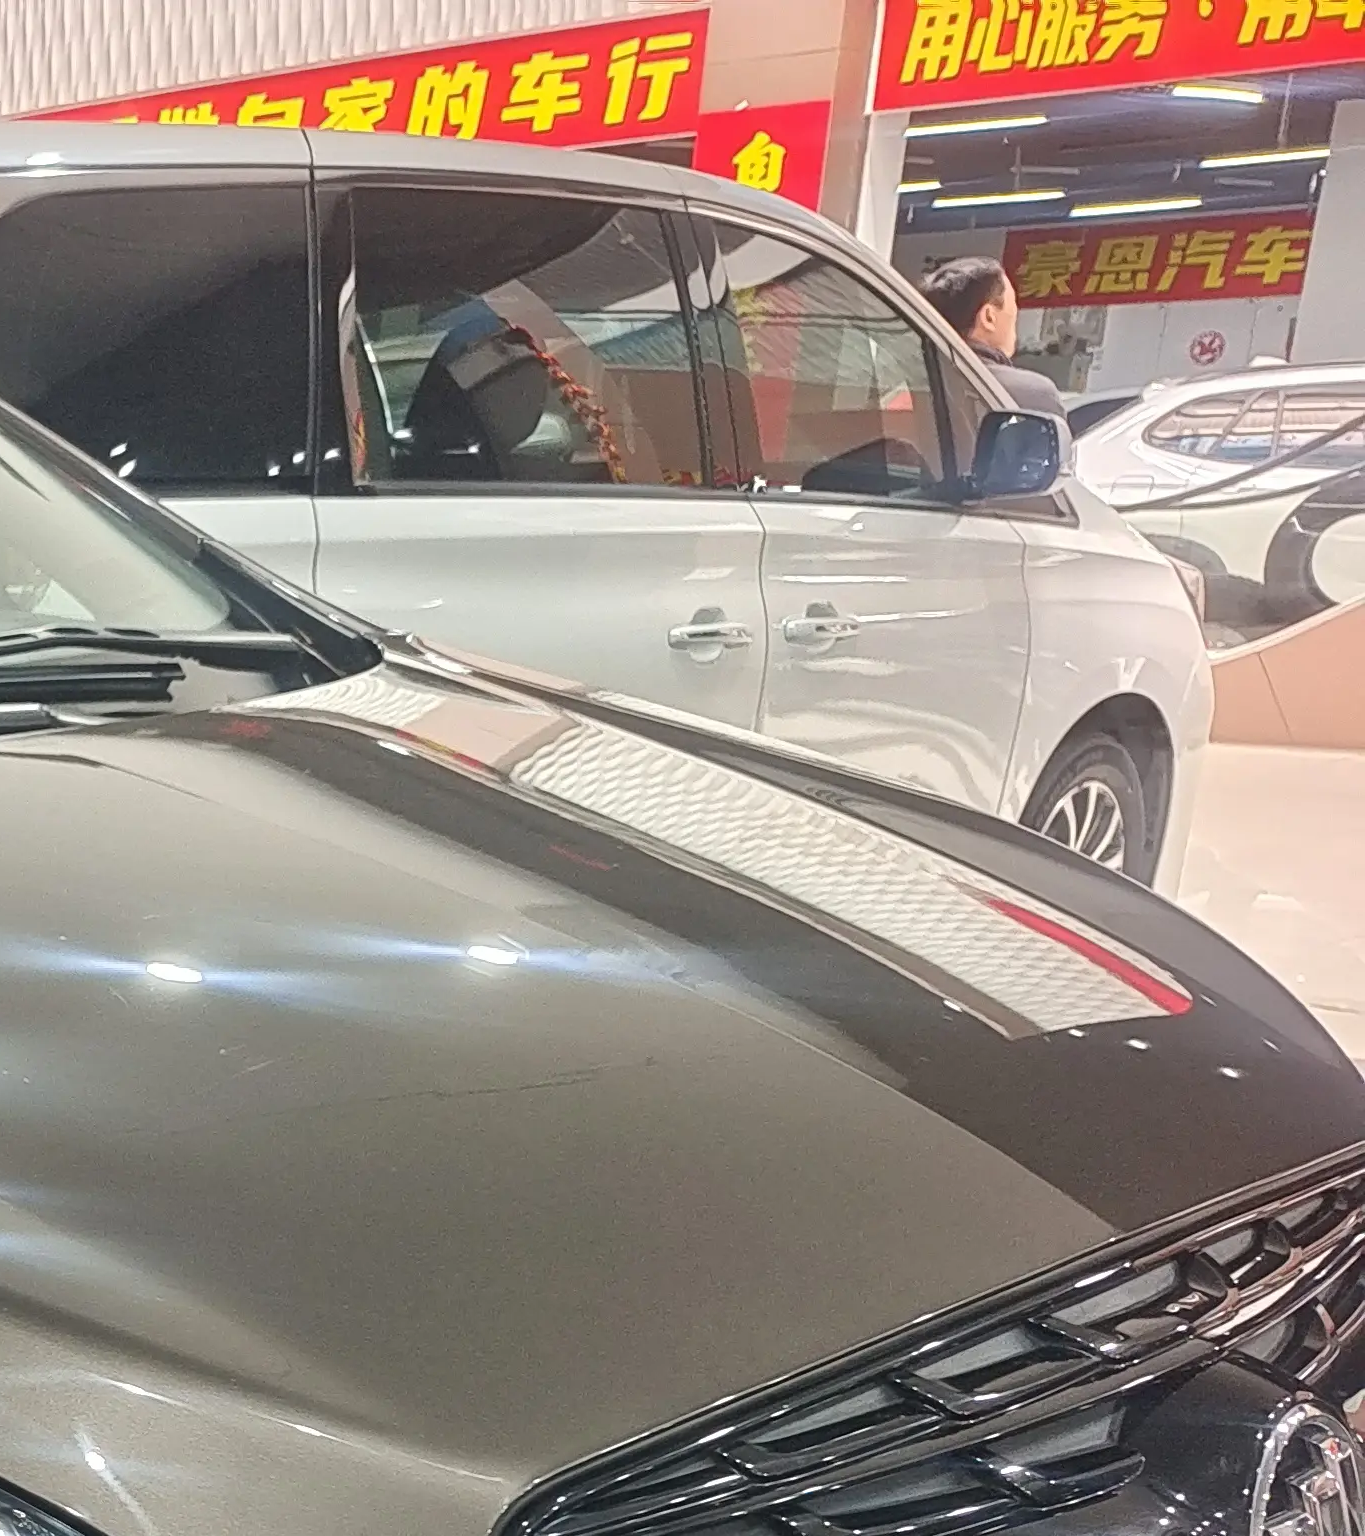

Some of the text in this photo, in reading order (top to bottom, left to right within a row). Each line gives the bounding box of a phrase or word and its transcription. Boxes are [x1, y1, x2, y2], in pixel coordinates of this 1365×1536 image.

[113, 28, 693, 140] 家的车行
[1017, 225, 1311, 297] 豪恩汽车
